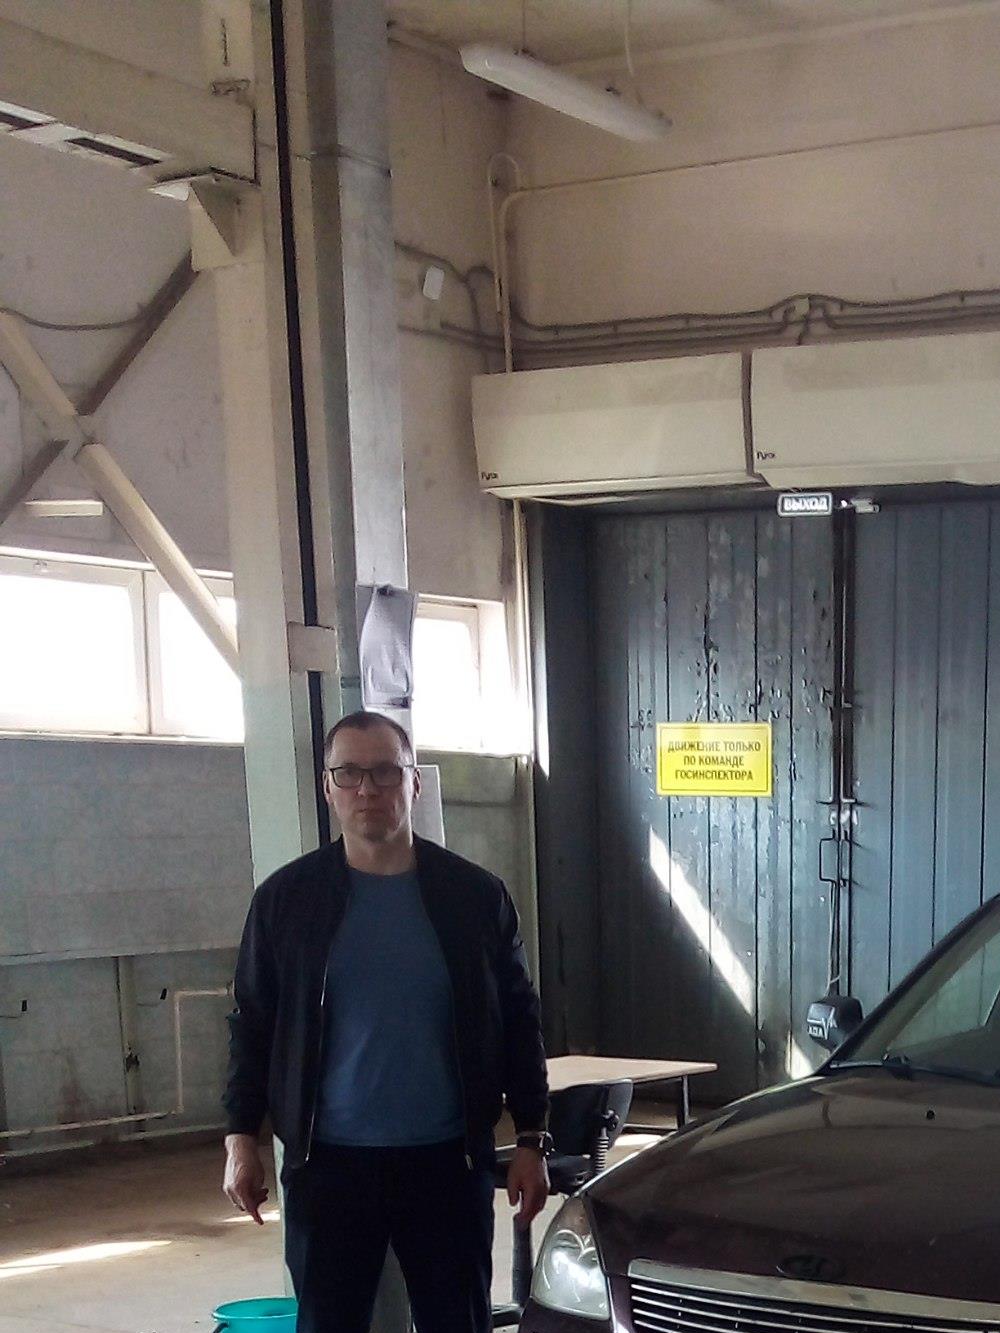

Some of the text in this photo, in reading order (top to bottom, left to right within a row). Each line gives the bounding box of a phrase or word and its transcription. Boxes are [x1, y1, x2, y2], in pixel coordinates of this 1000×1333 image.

[784, 498, 828, 511] ВЫХОД
[668, 741, 761, 753] ДВИЖЕНИЕ ТОЛЬКО
[683, 755, 744, 768] ПО КОМАНДЕ
[675, 769, 753, 780] ГОСИНСПЕКТОРА
